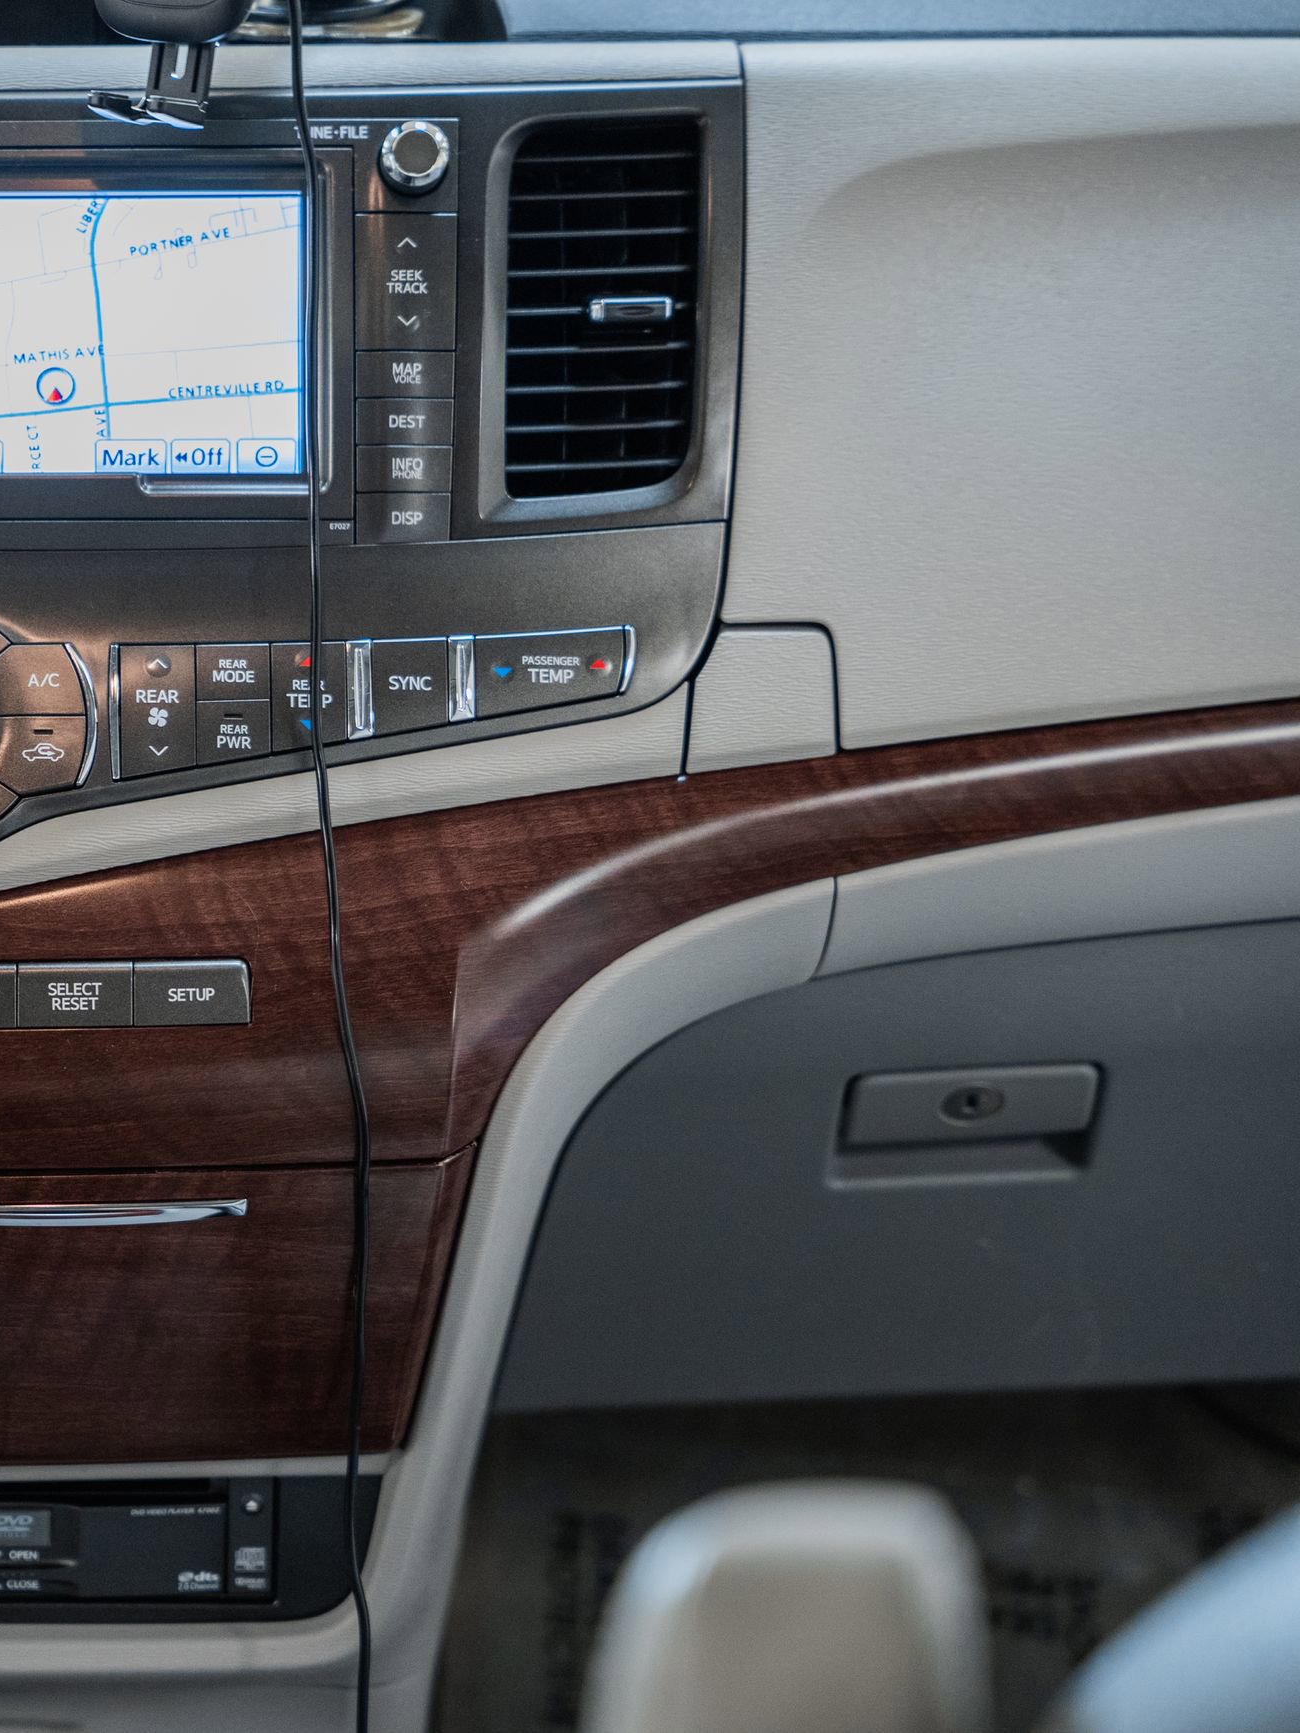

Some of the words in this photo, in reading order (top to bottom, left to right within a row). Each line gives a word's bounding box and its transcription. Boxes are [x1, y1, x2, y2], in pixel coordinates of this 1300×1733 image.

[130, 235, 194, 256] PORTNER
[200, 227, 230, 242] AVE
[390, 269, 423, 281] SEEK
[386, 282, 428, 294] TRACK
[13, 348, 69, 364] MATHIS
[75, 344, 104, 358] AVE
[392, 362, 422, 375] MAP
[393, 374, 421, 384] VOICE
[168, 382, 266, 400] CENTREVILLE
[266, 380, 284, 392] RD
[94, 409, 106, 437] AVE
[388, 415, 426, 429] DEST
[102, 448, 160, 466] Mark
[191, 447, 223, 466] Off
[391, 457, 423, 471] INFO
[392, 470, 422, 479] PHONE
[391, 511, 424, 525] DISP
[218, 659, 247, 669] REAR
[521, 655, 580, 666] PASSENGER
[28, 673, 60, 688] A/C
[212, 670, 255, 683] MODE
[388, 675, 432, 691] SYNC
[527, 668, 574, 684] TEMP
[292, 679, 325, 691] RER
[135, 689, 179, 704] REAR
[286, 693, 333, 708] TEP
[220, 724, 249, 735] REAR
[216, 735, 252, 749] PWR
[47, 982, 102, 997] SELECT
[167, 988, 215, 1002] SETUP
[51, 997, 98, 1011] RESET
[8, 1551, 40, 1561] OPEN
[194, 1571, 220, 1582] dts
[6, 1580, 41, 1590] CLOSE
